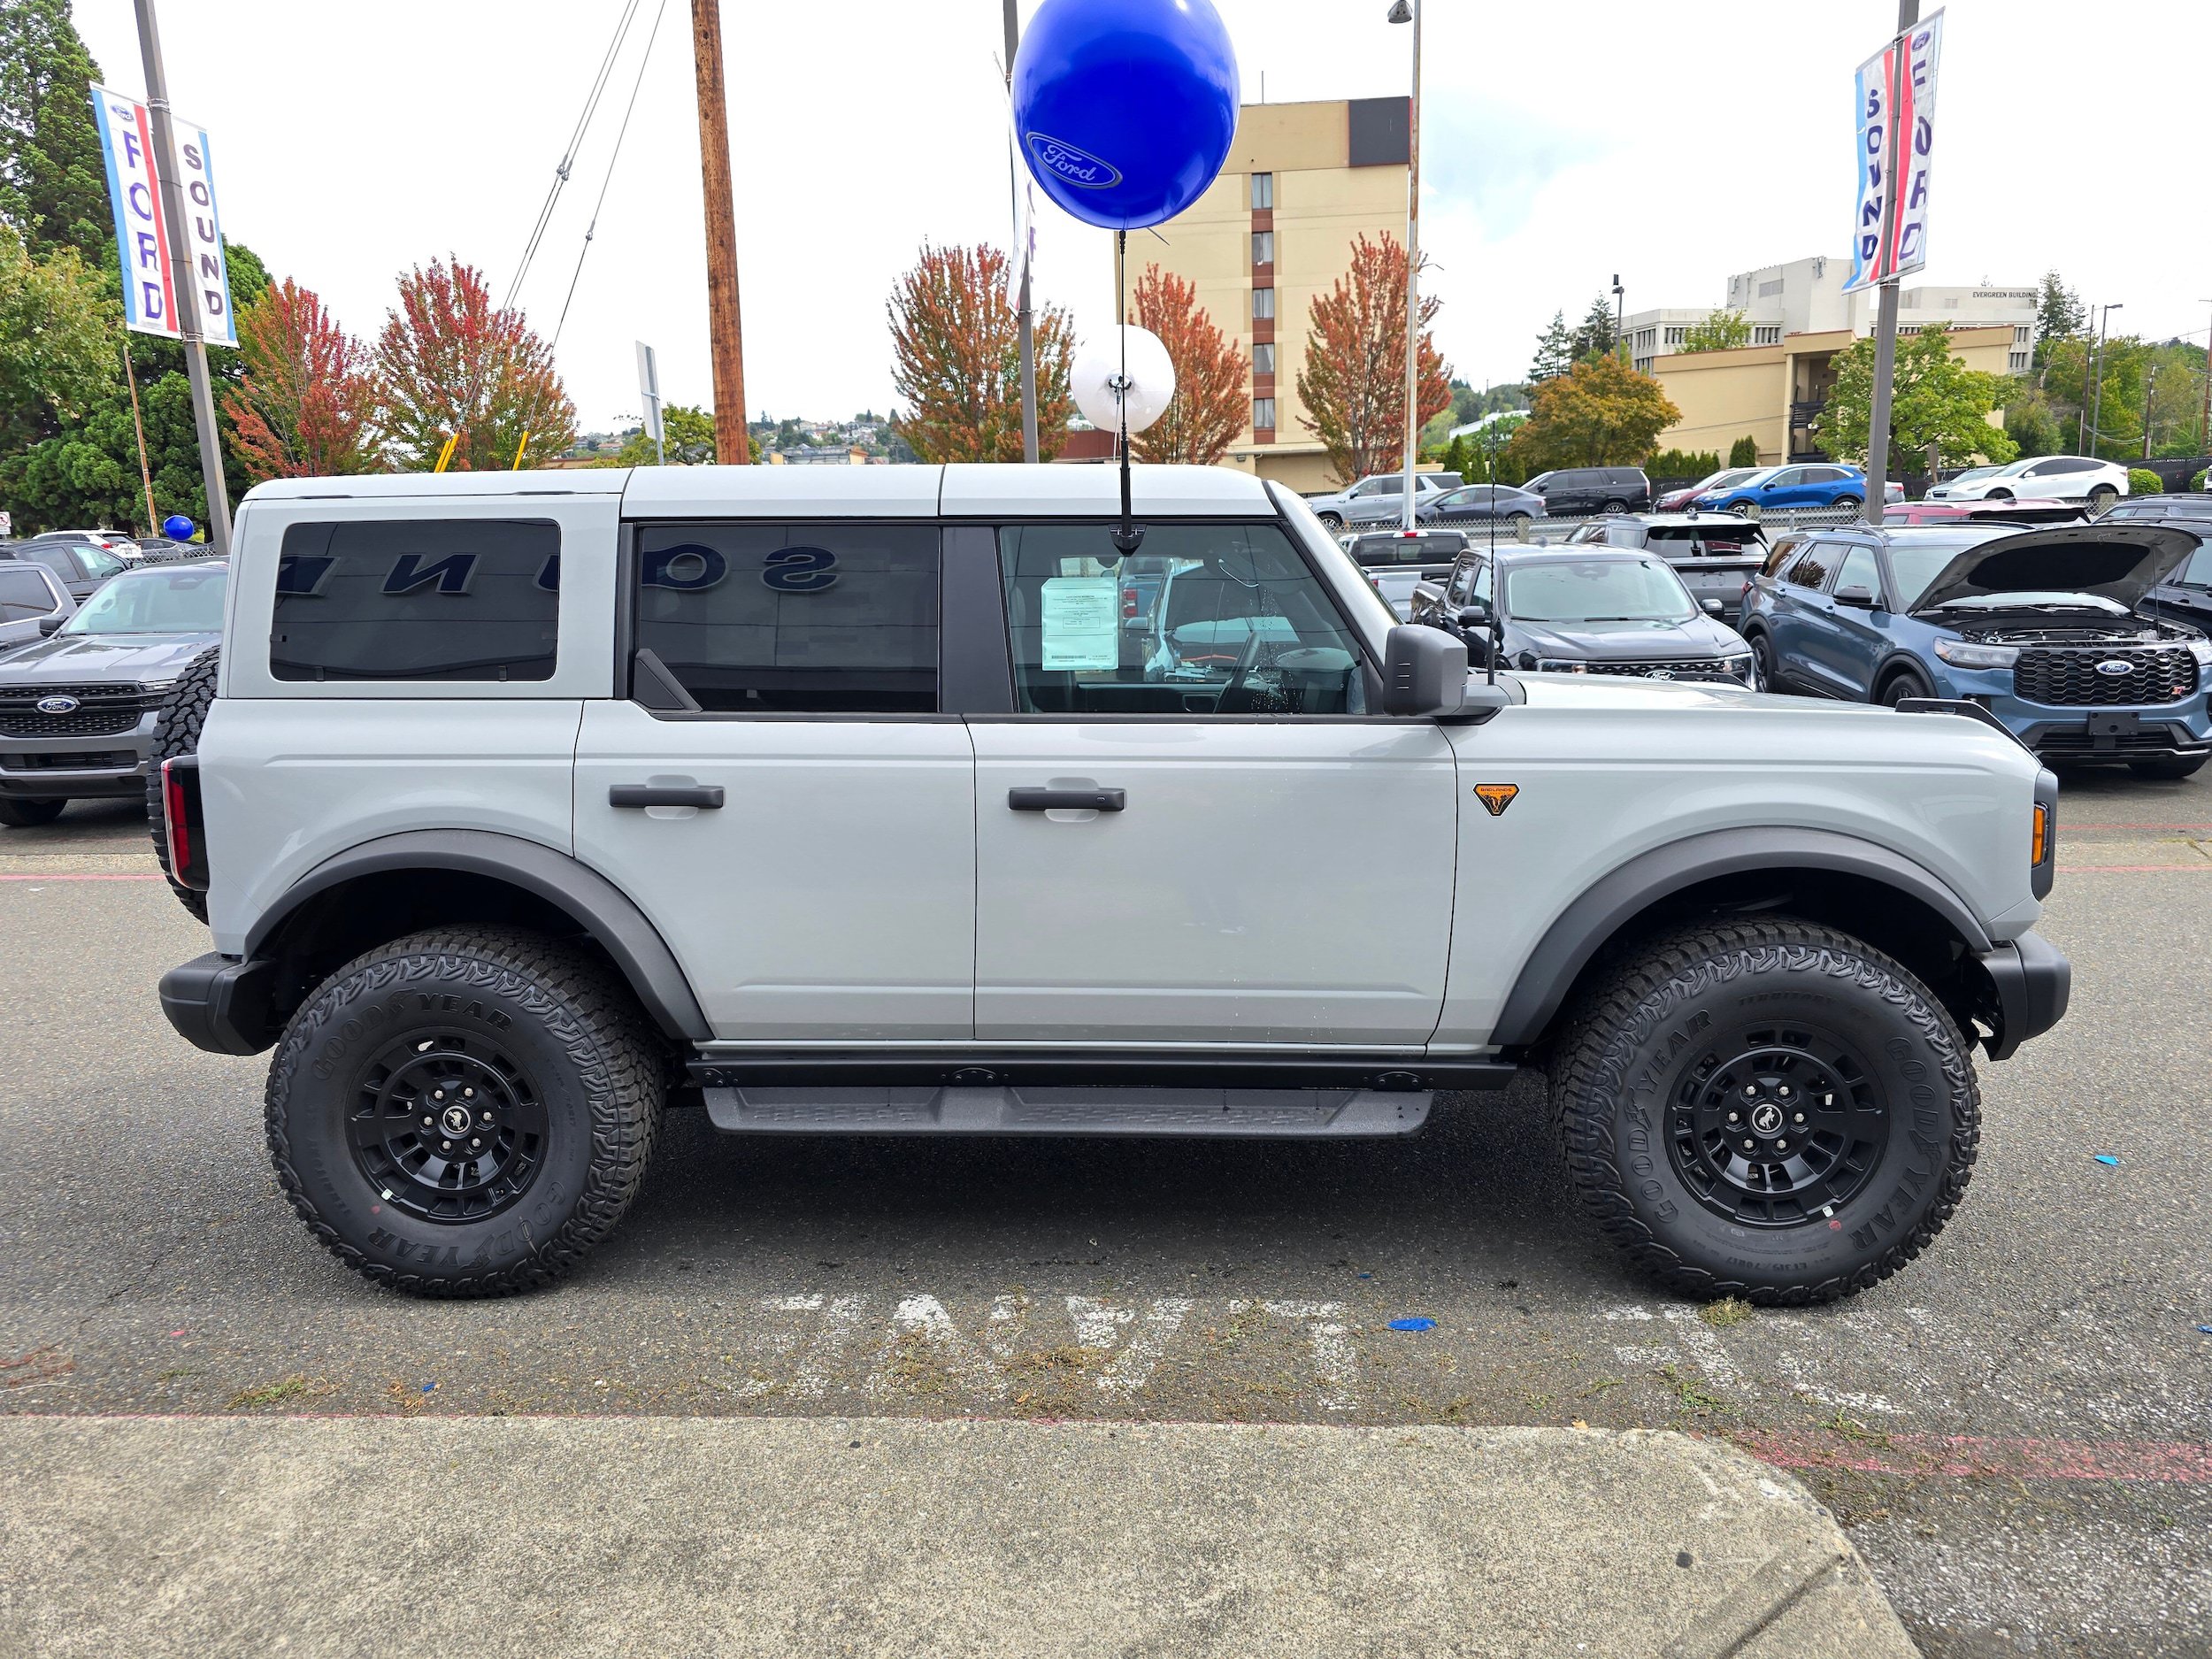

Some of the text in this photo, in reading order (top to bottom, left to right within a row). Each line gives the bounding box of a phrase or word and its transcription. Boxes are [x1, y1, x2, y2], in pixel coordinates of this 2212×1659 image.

[1042, 144, 1097, 180] Ford
[122, 130, 164, 319] FORD
[183, 143, 224, 316] SOUND
[46, 701, 67, 710] Ford
